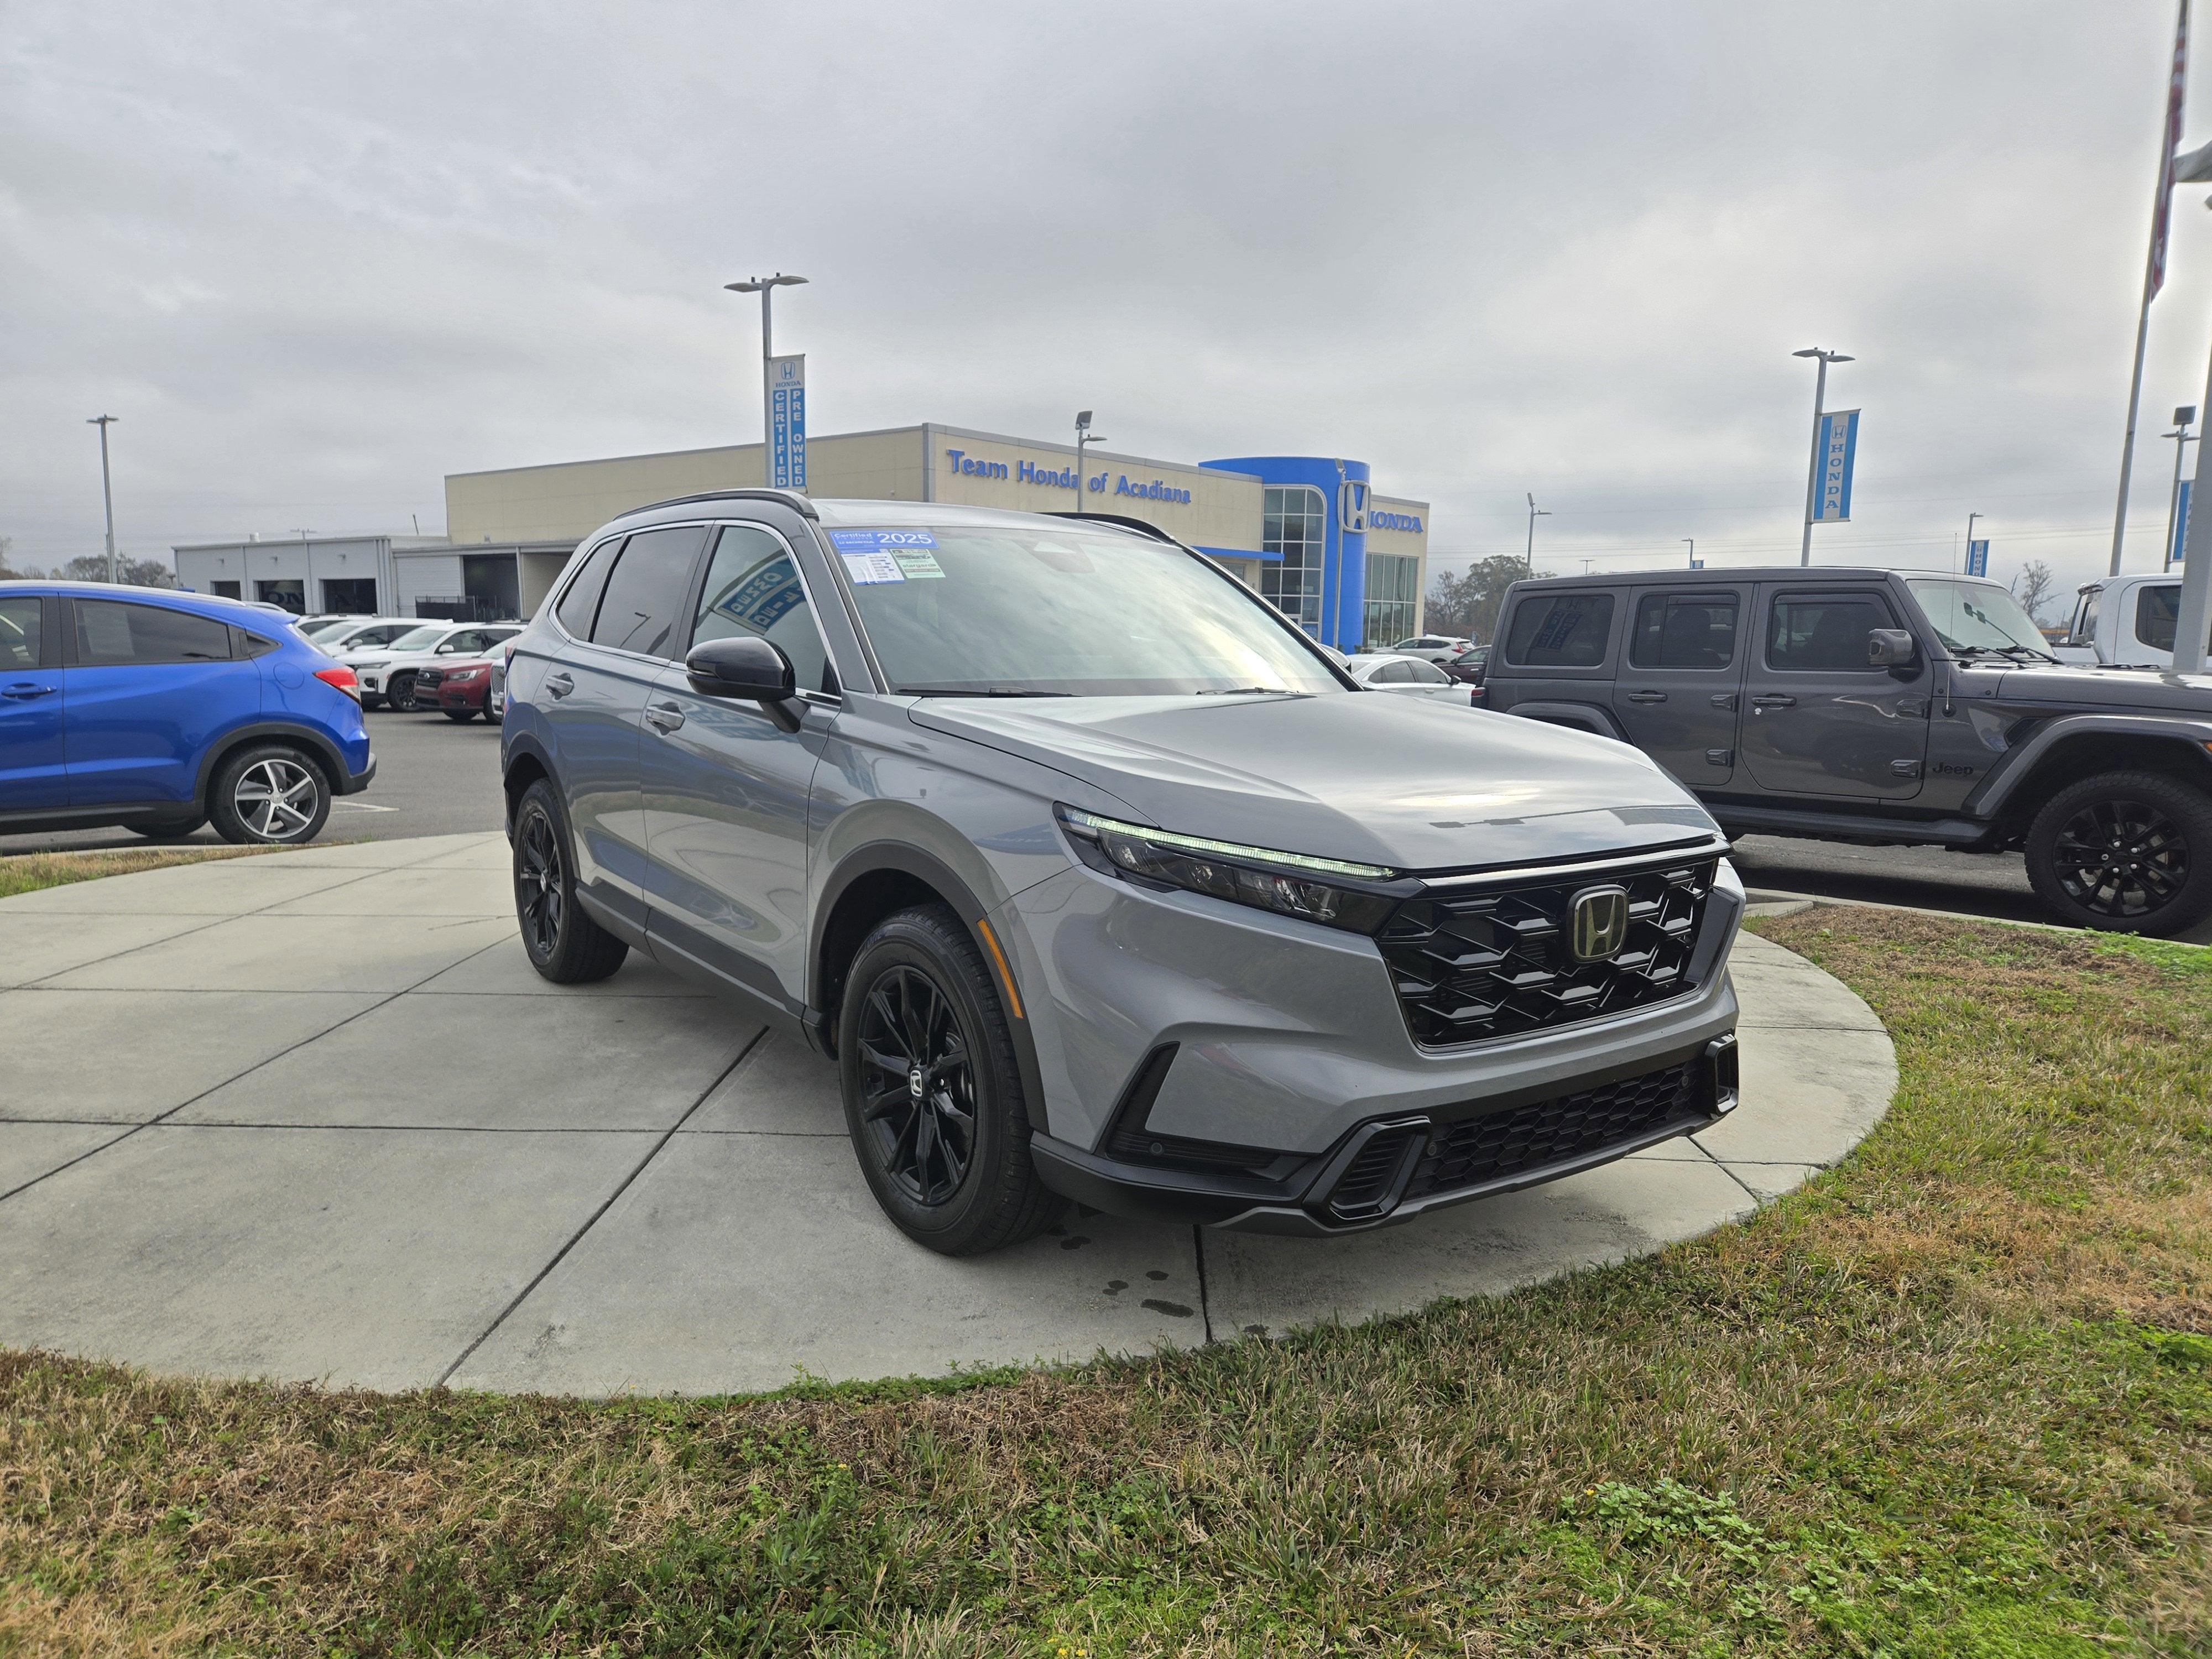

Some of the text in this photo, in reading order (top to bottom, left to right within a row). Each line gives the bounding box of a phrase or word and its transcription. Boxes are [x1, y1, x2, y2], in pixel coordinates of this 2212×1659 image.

[774, 392, 787, 486] CERTIFIED
[792, 390, 804, 485] PRE OWNED
[946, 449, 1192, 504] Team Honda of Acadiana
[1825, 444, 1844, 508] HONDA
[877, 533, 932, 544] 2025
[1974, 554, 1982, 576] HOND
[1932, 761, 1974, 777] Jeep
